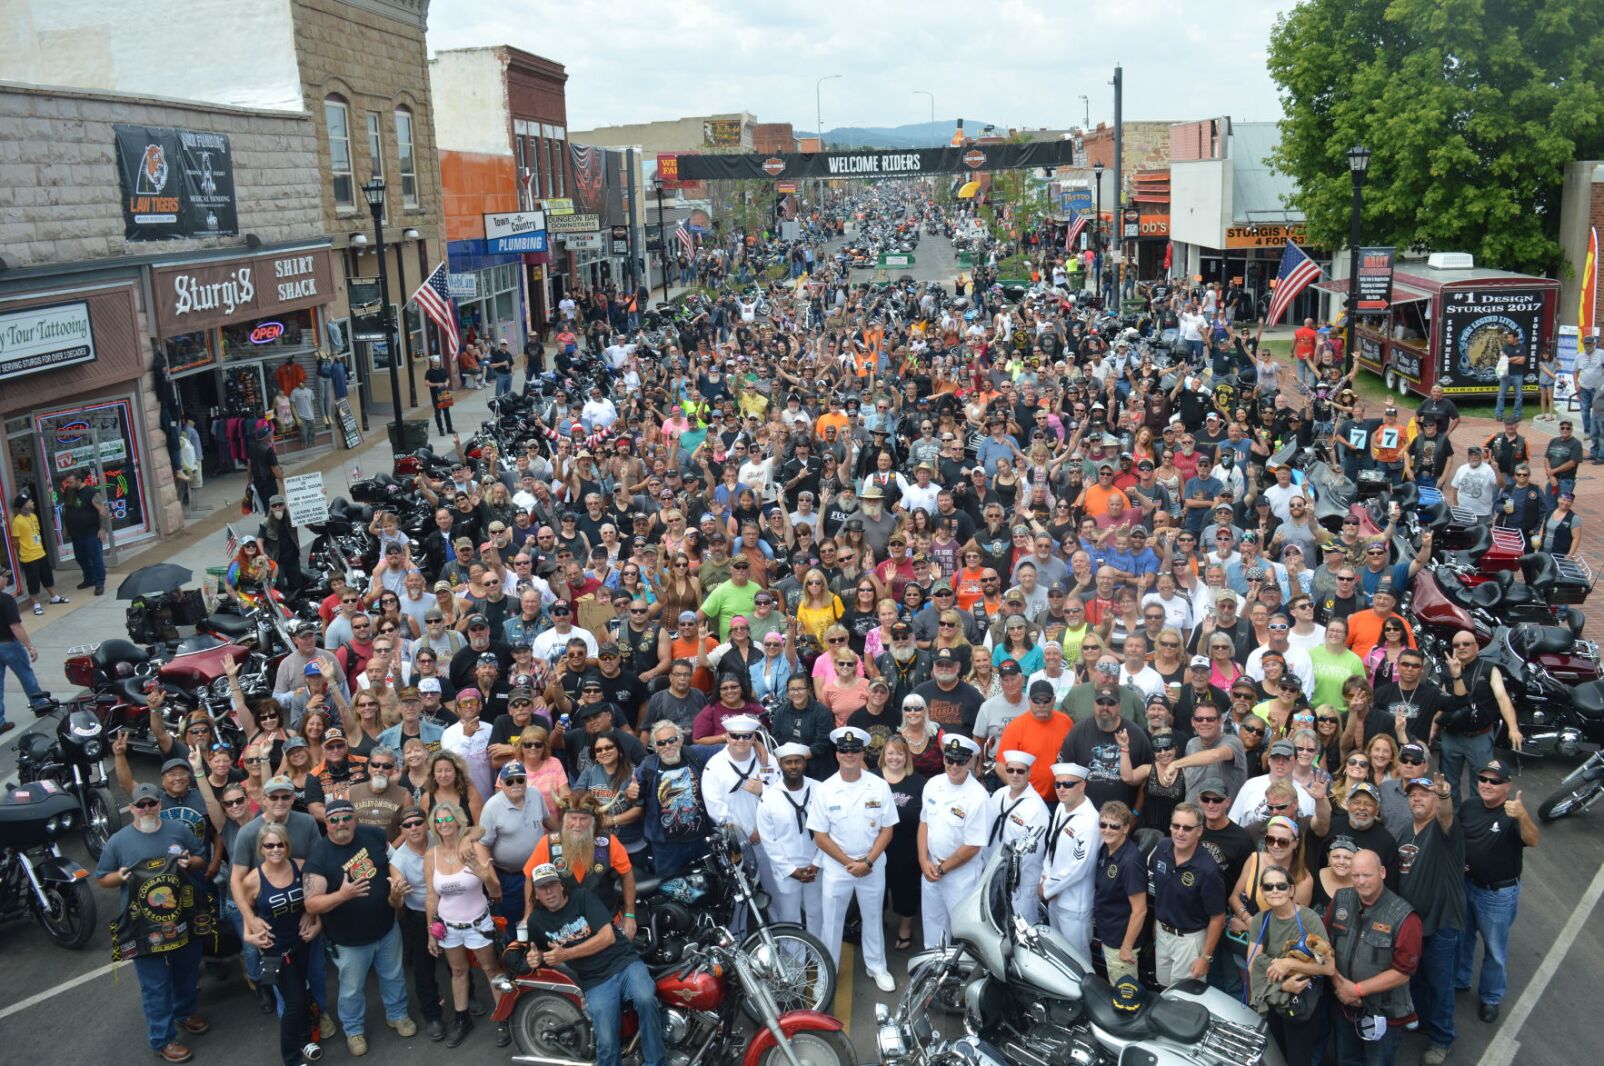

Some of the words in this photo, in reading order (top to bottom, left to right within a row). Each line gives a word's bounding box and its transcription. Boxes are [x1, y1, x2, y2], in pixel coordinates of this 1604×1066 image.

[829, 155, 878, 174] WELCOME
[881, 153, 920, 171] RIDERS
[130, 196, 151, 213] LAW
[152, 196, 179, 212] TIGERS
[493, 217, 510, 228] Town
[511, 220, 536, 232] Country
[548, 215, 582, 224] DUNGEON
[1227, 227, 1280, 238] STURGIS
[498, 236, 542, 252] PLUMBING
[1266, 237, 1287, 245] FOR
[275, 256, 314, 278] SHIRT
[278, 279, 317, 301] SHACK
[1453, 291, 1476, 303] #1
[1481, 295, 1534, 303] DESIGN
[1446, 305, 1504, 314] STURGIS
[1507, 303, 1542, 312] 2017
[7, 323, 35, 345] Tour
[37, 315, 87, 339] Tattooing
[252, 325, 280, 341] OPEN
[1461, 326, 1474, 342] THE
[1471, 315, 1498, 329] LEGEND
[1499, 315, 1518, 331] LIVES
[1531, 316, 1539, 342] SOLD
[2, 361, 22, 372] SERVING
[22, 357, 42, 367] STURGIS
[42, 355, 52, 363] FOR
[52, 352, 63, 361] OVER
[67, 347, 87, 358] DECADES
[1444, 346, 1452, 372] HERE
[1529, 344, 1537, 370] HERE
[1353, 432, 1364, 447] 7
[1385, 431, 1395, 446] 7
[58, 457, 72, 468] TV
[139, 875, 166, 899] COMBAT
